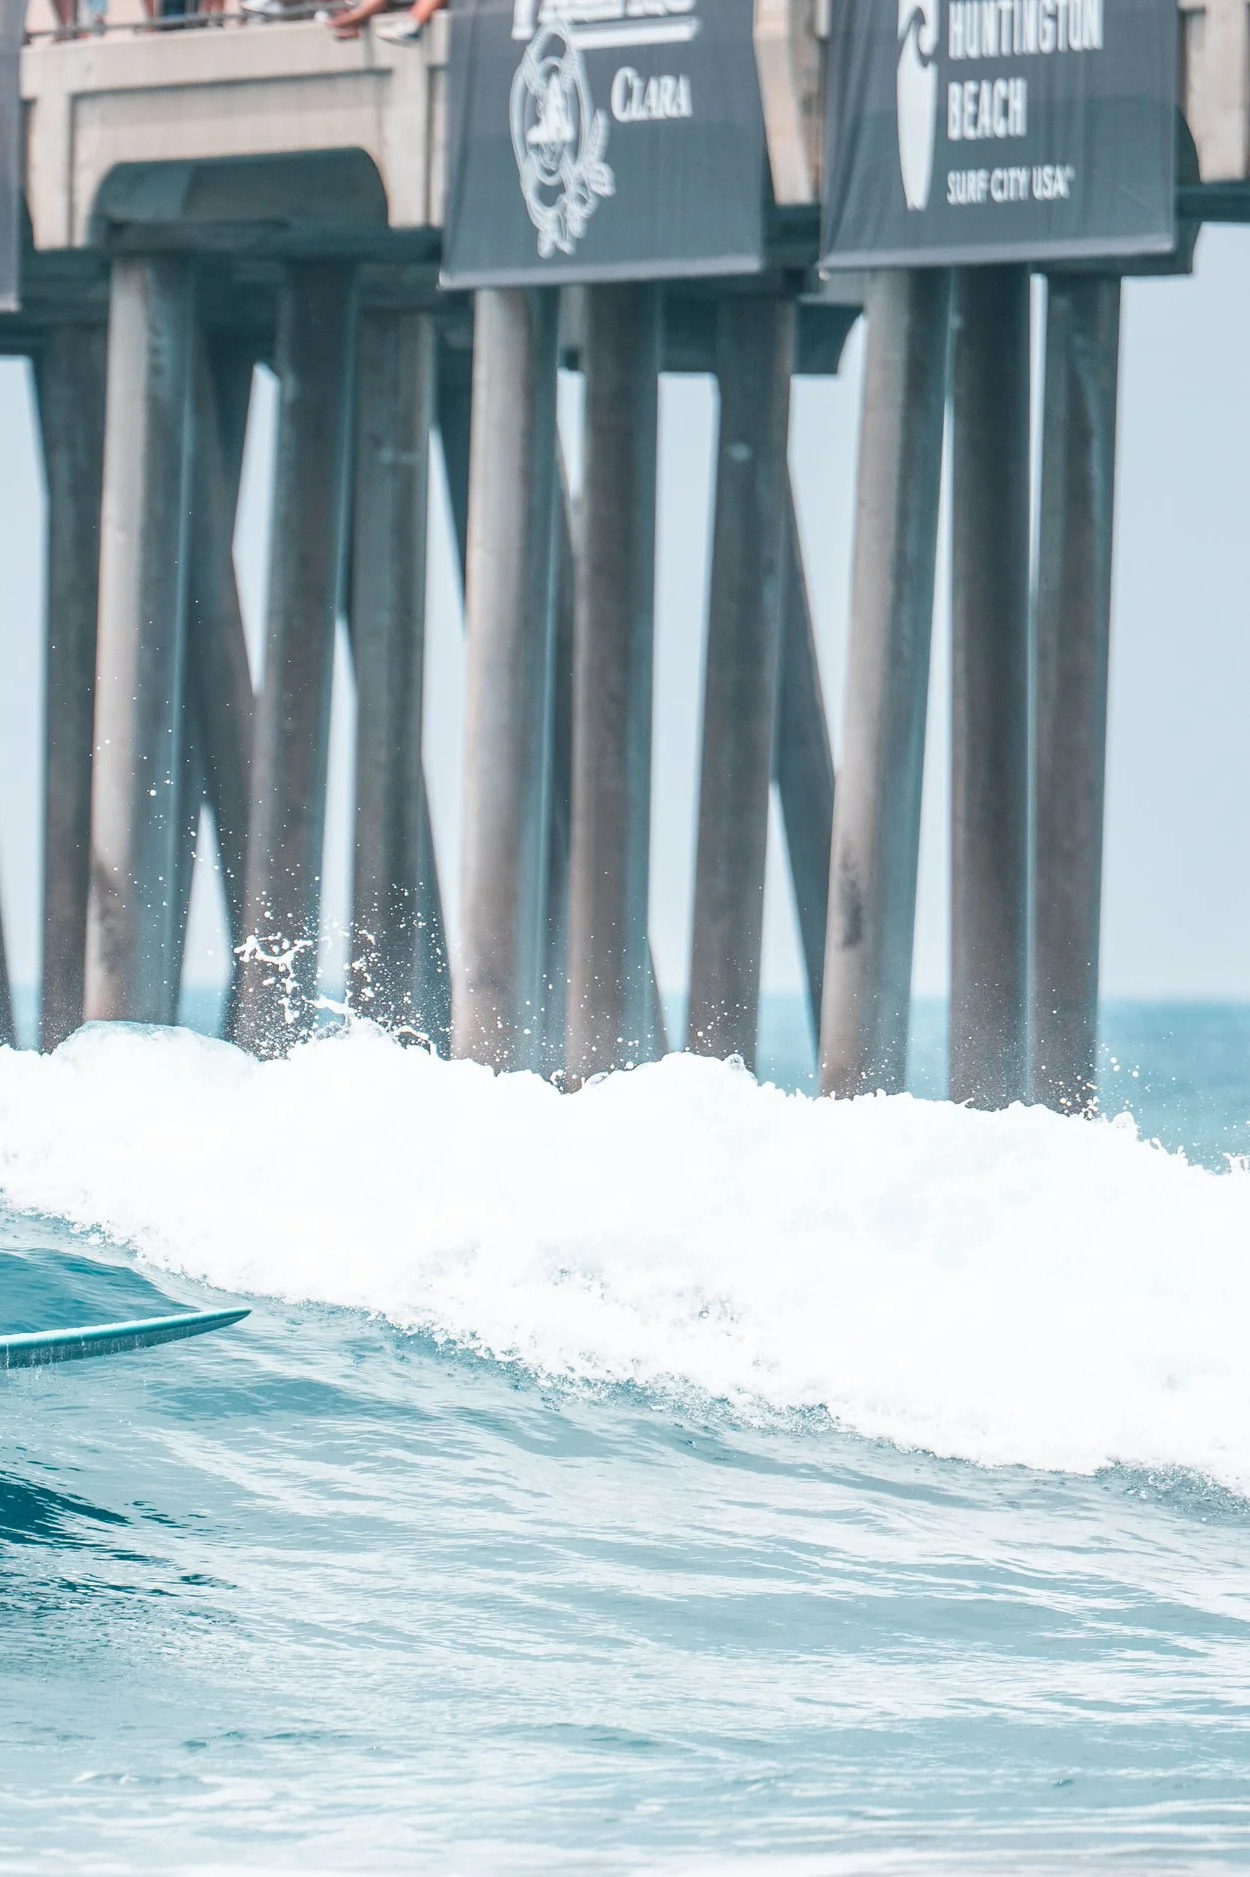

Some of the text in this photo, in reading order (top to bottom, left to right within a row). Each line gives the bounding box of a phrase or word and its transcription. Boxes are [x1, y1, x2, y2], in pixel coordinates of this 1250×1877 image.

[948, 0, 1104, 60] HUNTINGTON
[947, 77, 1028, 141] BEACH
[946, 168, 990, 206] SURF
[990, 166, 1031, 204] CITY
